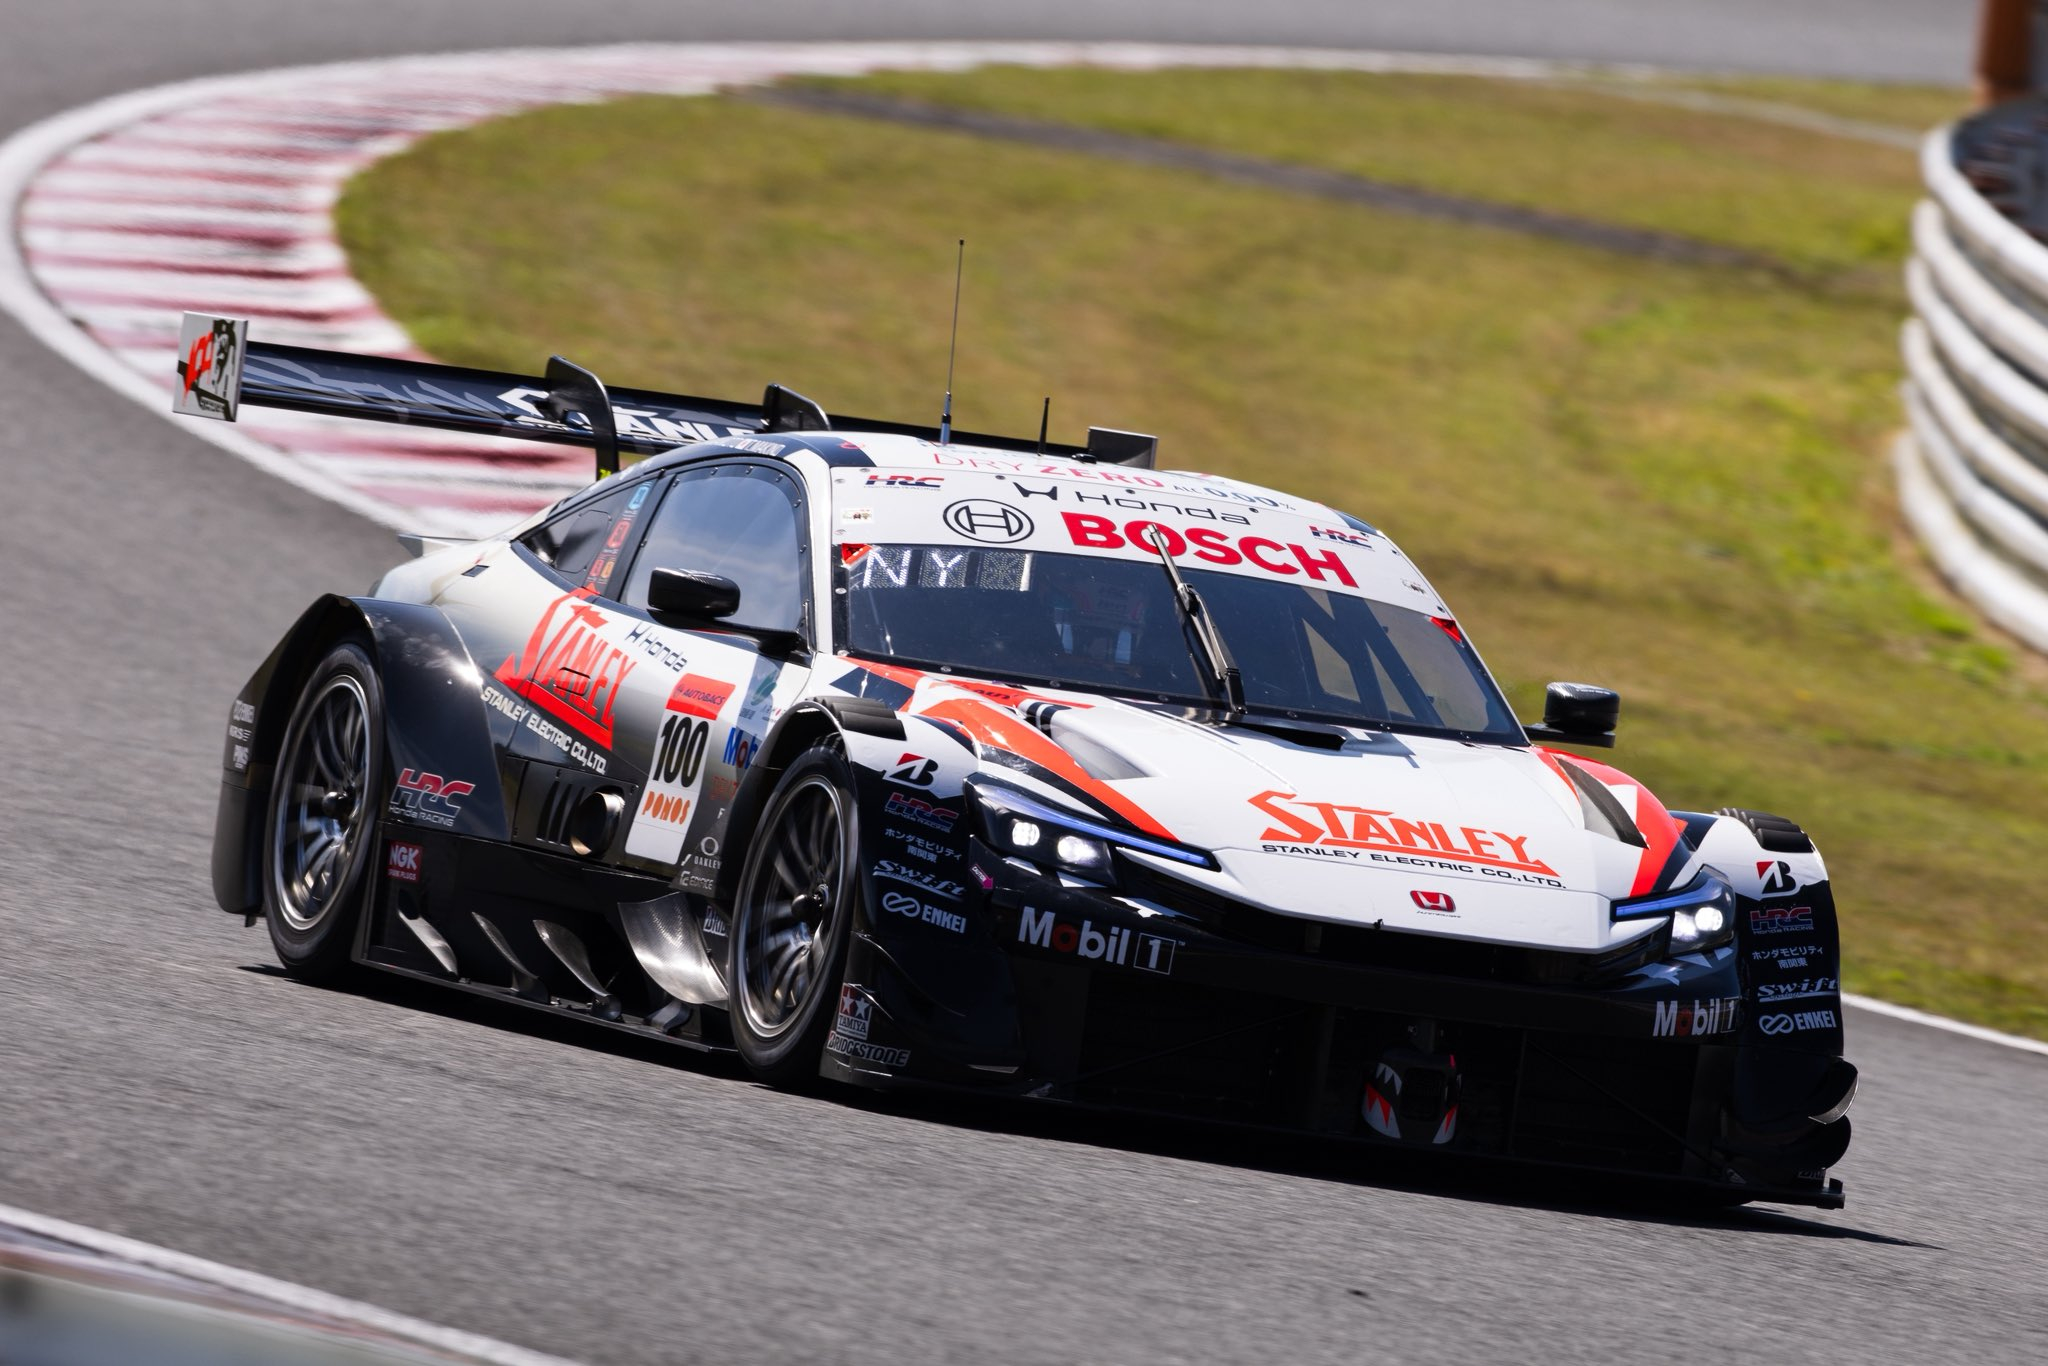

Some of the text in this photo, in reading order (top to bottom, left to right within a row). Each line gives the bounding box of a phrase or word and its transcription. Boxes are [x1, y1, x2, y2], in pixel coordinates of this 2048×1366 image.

[865, 475, 945, 488] HRC
[934, 453, 1022, 471] DRY
[1034, 463, 1163, 487] ZERO
[1075, 491, 1251, 525] Honda
[1061, 511, 1360, 588] BOSCH
[1309, 526, 1373, 549] HRC
[493, 583, 638, 750] STANLEY
[638, 628, 688, 672] Honda
[683, 688, 727, 705] AUTOBACS
[481, 687, 529, 723] STANLEY
[526, 711, 574, 752] ELECTRIC
[653, 714, 710, 788] 100
[390, 768, 476, 818] HRC
[641, 791, 690, 825] PONOS
[388, 805, 455, 827] Honda RACING
[885, 792, 959, 829] HRC
[885, 828, 962, 860] ホンダモビリティ
[1247, 790, 1561, 877] STANLEY
[389, 844, 419, 870] NGK
[694, 856, 722, 870] OAKLEY
[1261, 844, 1360, 860] STANLEY
[1370, 853, 1474, 873] ELECTRIC
[921, 904, 967, 934] ENKEI
[1751, 907, 1812, 931] HRC
[1018, 906, 1131, 965] Mobil
[1148, 938, 1162, 969] 1
[1752, 945, 1824, 961] ホンダモビリティ
[839, 1015, 867, 1033] TAMIYA
[1653, 1000, 1720, 1037] Mobil
[1793, 1010, 1837, 1031] ENKEI
[828, 1031, 911, 1066] BRIDGESTONE
